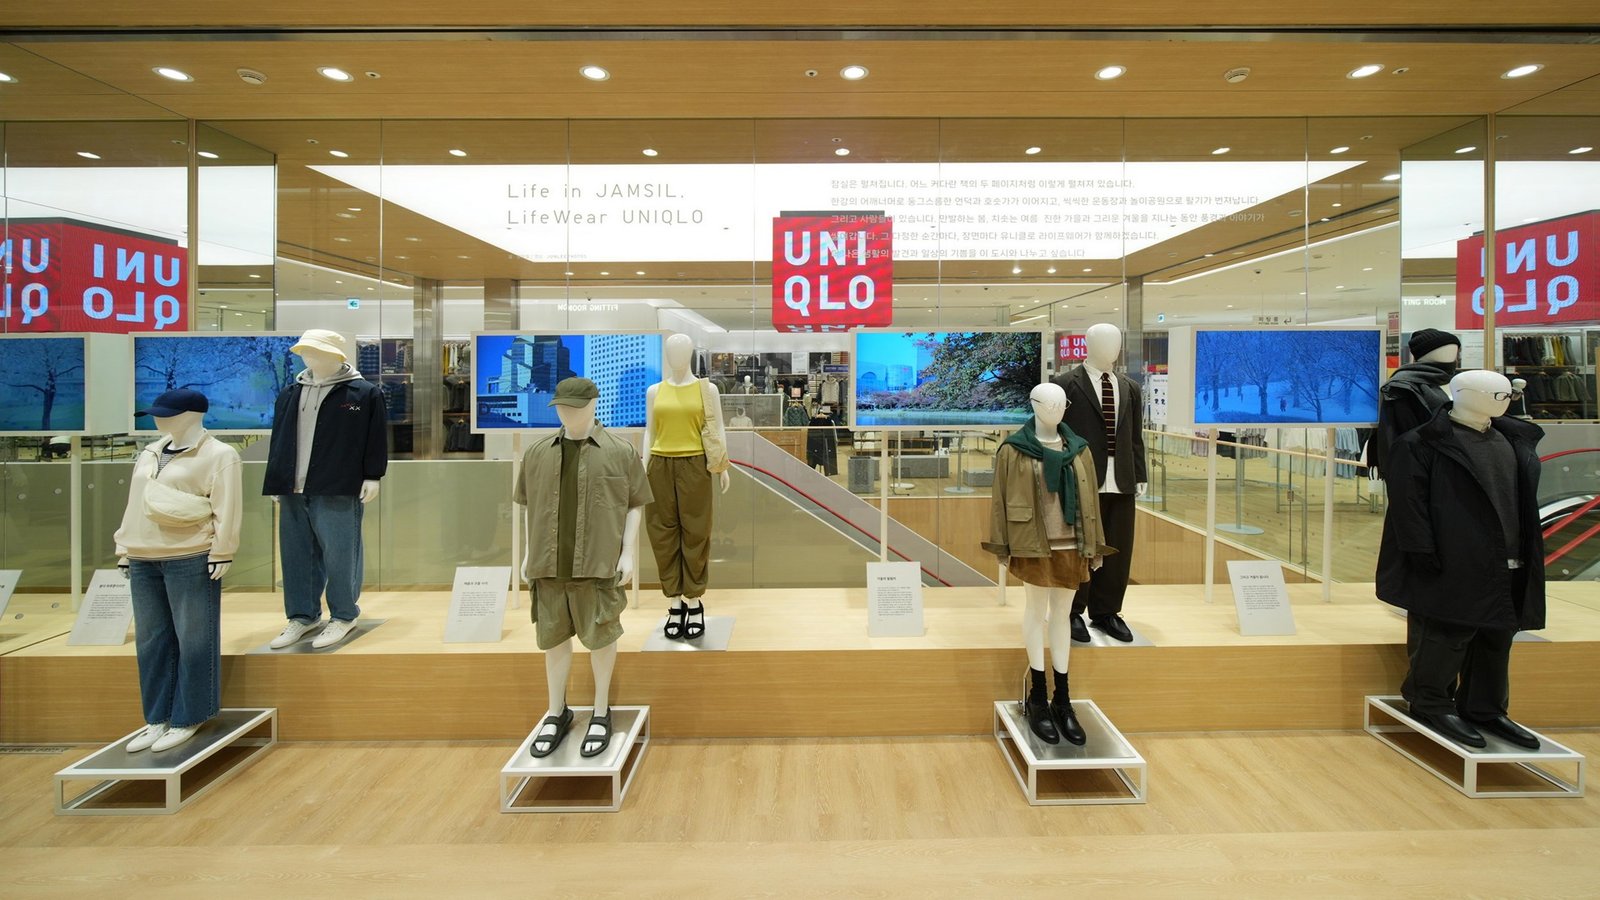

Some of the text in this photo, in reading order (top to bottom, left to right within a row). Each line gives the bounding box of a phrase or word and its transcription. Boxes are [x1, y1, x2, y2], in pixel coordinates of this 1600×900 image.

[831, 180, 1134, 188] 잠실은 펼쳐집니다. 어느 커다란 책의 두 페이지처럼 이렇게 펼쳐져 있습니다.
[508, 184, 550, 198] Life
[564, 184, 581, 198] in
[831, 198, 858, 206] 한강의
[860, 197, 905, 206] 어깨너머로
[955, 197, 981, 206] 언덕과
[984, 197, 1019, 206] 호숫가가
[1022, 197, 1060, 206] 이어지고,
[1064, 197, 1089, 206] 씩씩한
[1092, 197, 1127, 206] 운동장과
[1130, 197, 1183, 205] 놀이공원으로
[1186, 197, 1212, 205] 활기가
[508, 210, 704, 226] LifeWear UNIQLO
[831, 214, 858, 224] 그리고
[860, 214, 896, 223] 사람들이
[898, 214, 935, 223] 있습니다.
[938, 214, 974, 223] 만발하는
[992, 214, 1018, 223] 치솟는
[1020, 214, 1038, 223] 여름
[1044, 214, 1061, 223] 진한
[1064, 214, 1090, 223] 가을과
[1093, 214, 1120, 223] 그리운
[1122, 214, 1148, 223] 겨울을
[1152, 214, 1178, 223] 지나는
[1180, 214, 1198, 223] 동안
[1230, 214, 1265, 223] 이야기가
[892, 232, 918, 240] 다정한
[922, 232, 960, 240] 순간마다,
[962, 232, 998, 240] 장면마다
[1000, 232, 1036, 240] 유니클로
[1038, 232, 1092, 240] 라이프웨어가
[1096, 232, 1159, 240] 함께하겠습니다.
[784, 231, 866, 266] UNI
[892, 249, 918, 258] 발견과
[922, 249, 948, 258] 일상의
[951, 249, 976, 258] 기쁨을
[980, 249, 988, 258] 이
[992, 249, 1018, 258] 도시와
[1020, 249, 1047, 258] 나누고
[784, 275, 874, 316] QLO
[1073, 338, 1087, 346] UN
[1073, 348, 1088, 358] QL
